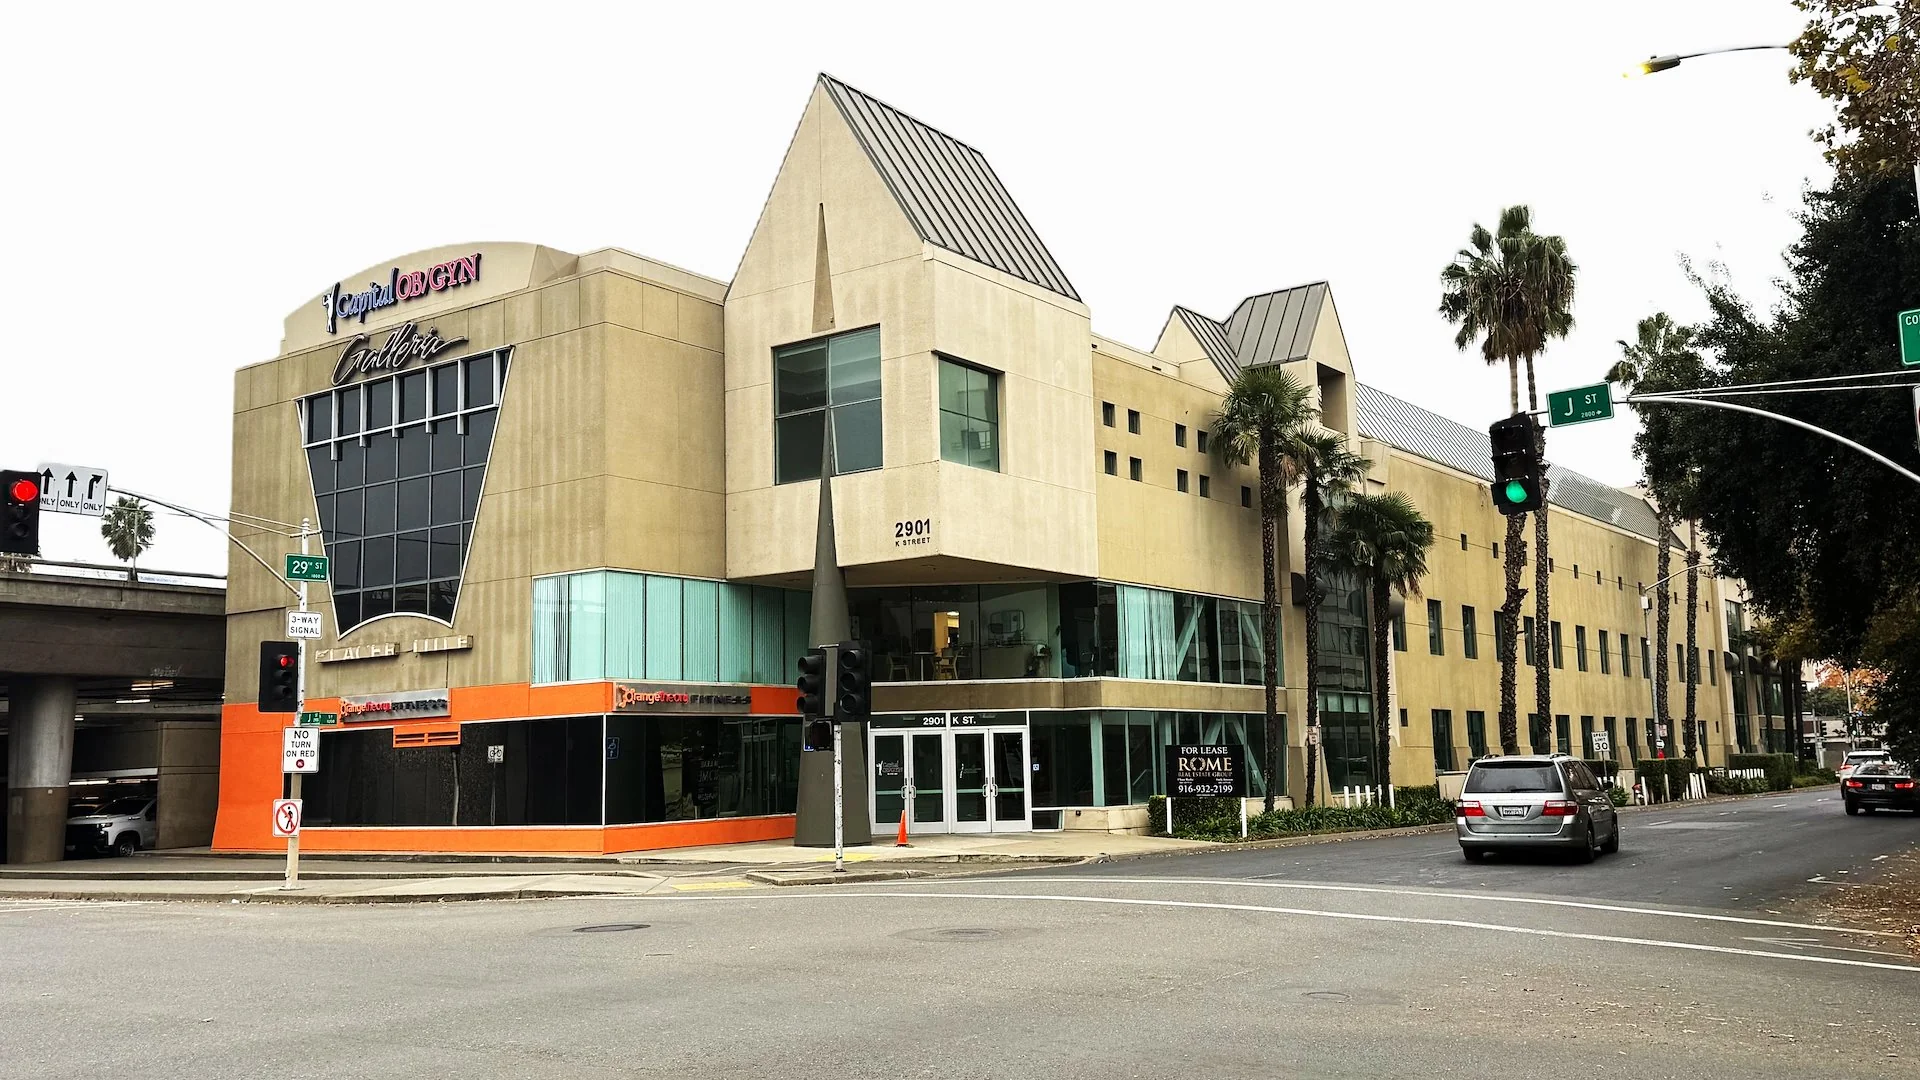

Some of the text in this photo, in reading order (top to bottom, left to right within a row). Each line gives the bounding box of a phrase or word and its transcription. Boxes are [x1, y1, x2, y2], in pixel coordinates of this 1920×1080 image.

[335, 253, 480, 322] Capital OB/GYN
[331, 321, 468, 386] Galleria
[1564, 393, 1597, 416] J ST
[40, 497, 55, 505] NLY
[60, 499, 80, 508] ONLY
[83, 502, 103, 511] ONLY
[895, 518, 930, 538] 2901
[902, 537, 931, 546] STREET
[315, 562, 323, 570] ST
[291, 615, 319, 624] 3-WAY
[290, 626, 320, 635] SIGNAL
[922, 716, 976, 725] 2901 K ST.
[294, 730, 309, 739] NO
[1181, 746, 1228, 754] FOR LEASE
[1594, 742, 1608, 750] 30
[1178, 757, 1232, 771] ROME
[1178, 785, 1233, 793] 916-932-2199
